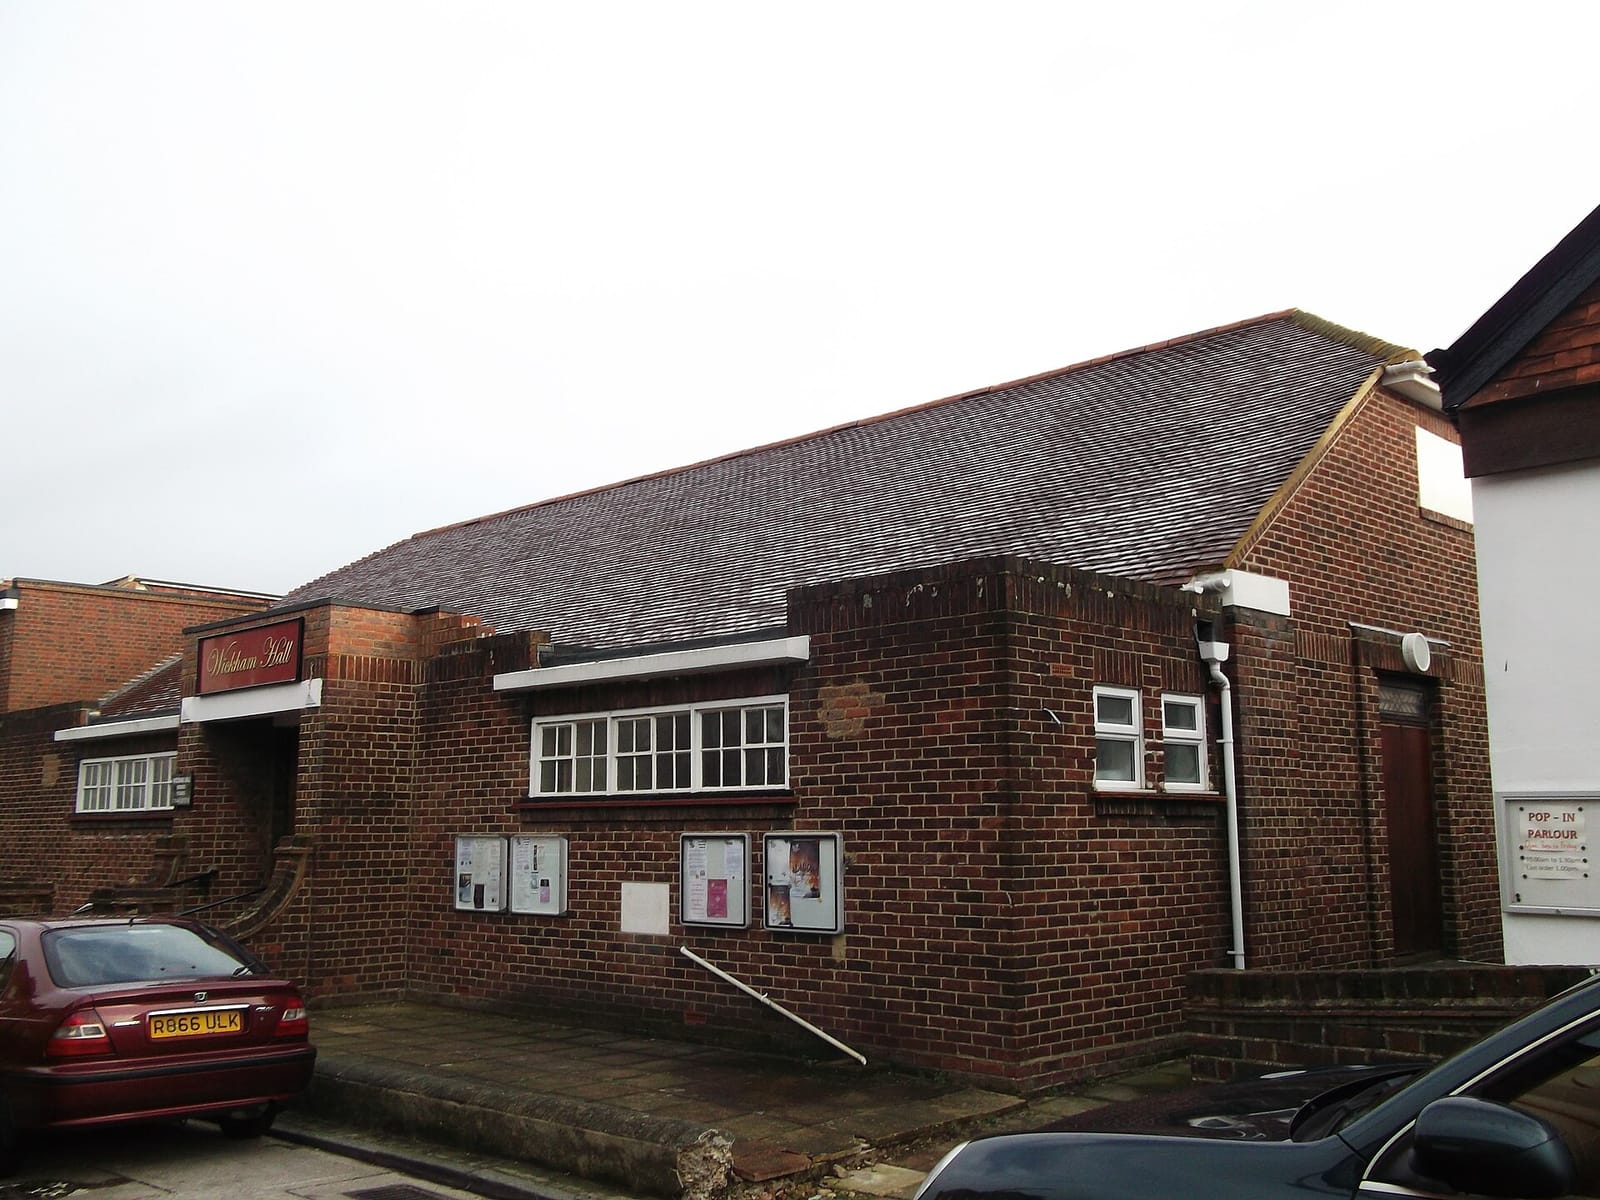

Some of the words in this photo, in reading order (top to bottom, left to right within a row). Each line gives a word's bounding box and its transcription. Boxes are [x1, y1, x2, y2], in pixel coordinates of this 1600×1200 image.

[206, 641, 258, 677] Wickham
[260, 636, 294, 668] Hall
[1528, 812, 1550, 822] POP
[1562, 812, 1575, 822] IN
[1528, 829, 1578, 839] PARLOUR
[153, 1016, 201, 1034] R866
[205, 1013, 239, 1030] ULK
